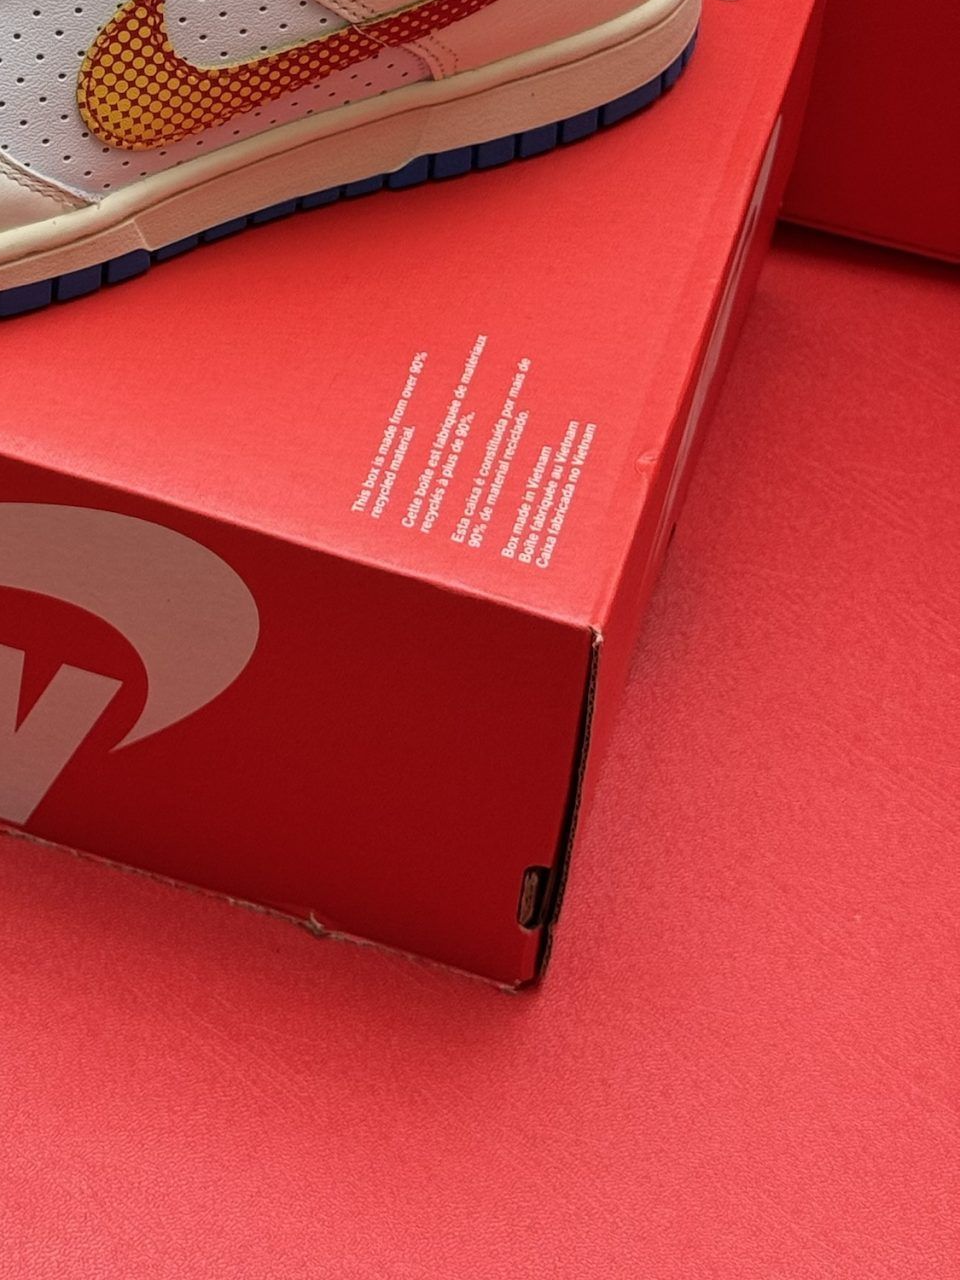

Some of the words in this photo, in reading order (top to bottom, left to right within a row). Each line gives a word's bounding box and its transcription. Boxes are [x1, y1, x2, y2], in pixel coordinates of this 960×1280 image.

[409, 351, 428, 374] 90%
[460, 334, 488, 384] matériaux
[401, 374, 418, 399] over
[453, 384, 468, 399] de
[388, 399, 409, 425] from
[432, 399, 462, 449] fabriquée
[455, 411, 476, 438] 90%.
[378, 424, 398, 455] made
[450, 438, 465, 453] de
[450, 517, 471, 543] Esta
[464, 486, 483, 516] caixa
[479, 418, 509, 477] constituída
[501, 398, 515, 419] por
[508, 372, 526, 398] mais
[517, 357, 532, 372] de
[553, 420, 580, 463] Vietnam
[571, 423, 597, 466] Vietnam
[371, 470, 397, 519] recycled
[389, 426, 416, 471] material.
[373, 455, 385, 467] is
[427, 449, 442, 468] est
[441, 453, 459, 479] plus
[525, 445, 552, 489] Vietnam
[552, 465, 563, 480] au
[361, 467, 381, 489] box
[413, 468, 435, 497] boîte
[467, 523, 487, 548] 90%
[478, 506, 493, 522] de
[486, 460, 510, 506] material
[503, 410, 530, 460] reciclado.
[568, 467, 581, 483] no
[351, 489, 371, 512] This
[420, 487, 446, 534] recyclés
[521, 490, 536, 502] in
[529, 481, 558, 531] fabriquée
[547, 483, 576, 535] fabricada
[401, 497, 423, 528] Cette
[512, 502, 532, 535] made
[500, 535, 520, 559] Box
[518, 533, 539, 564] Boîte
[535, 536, 557, 569] Caixa
